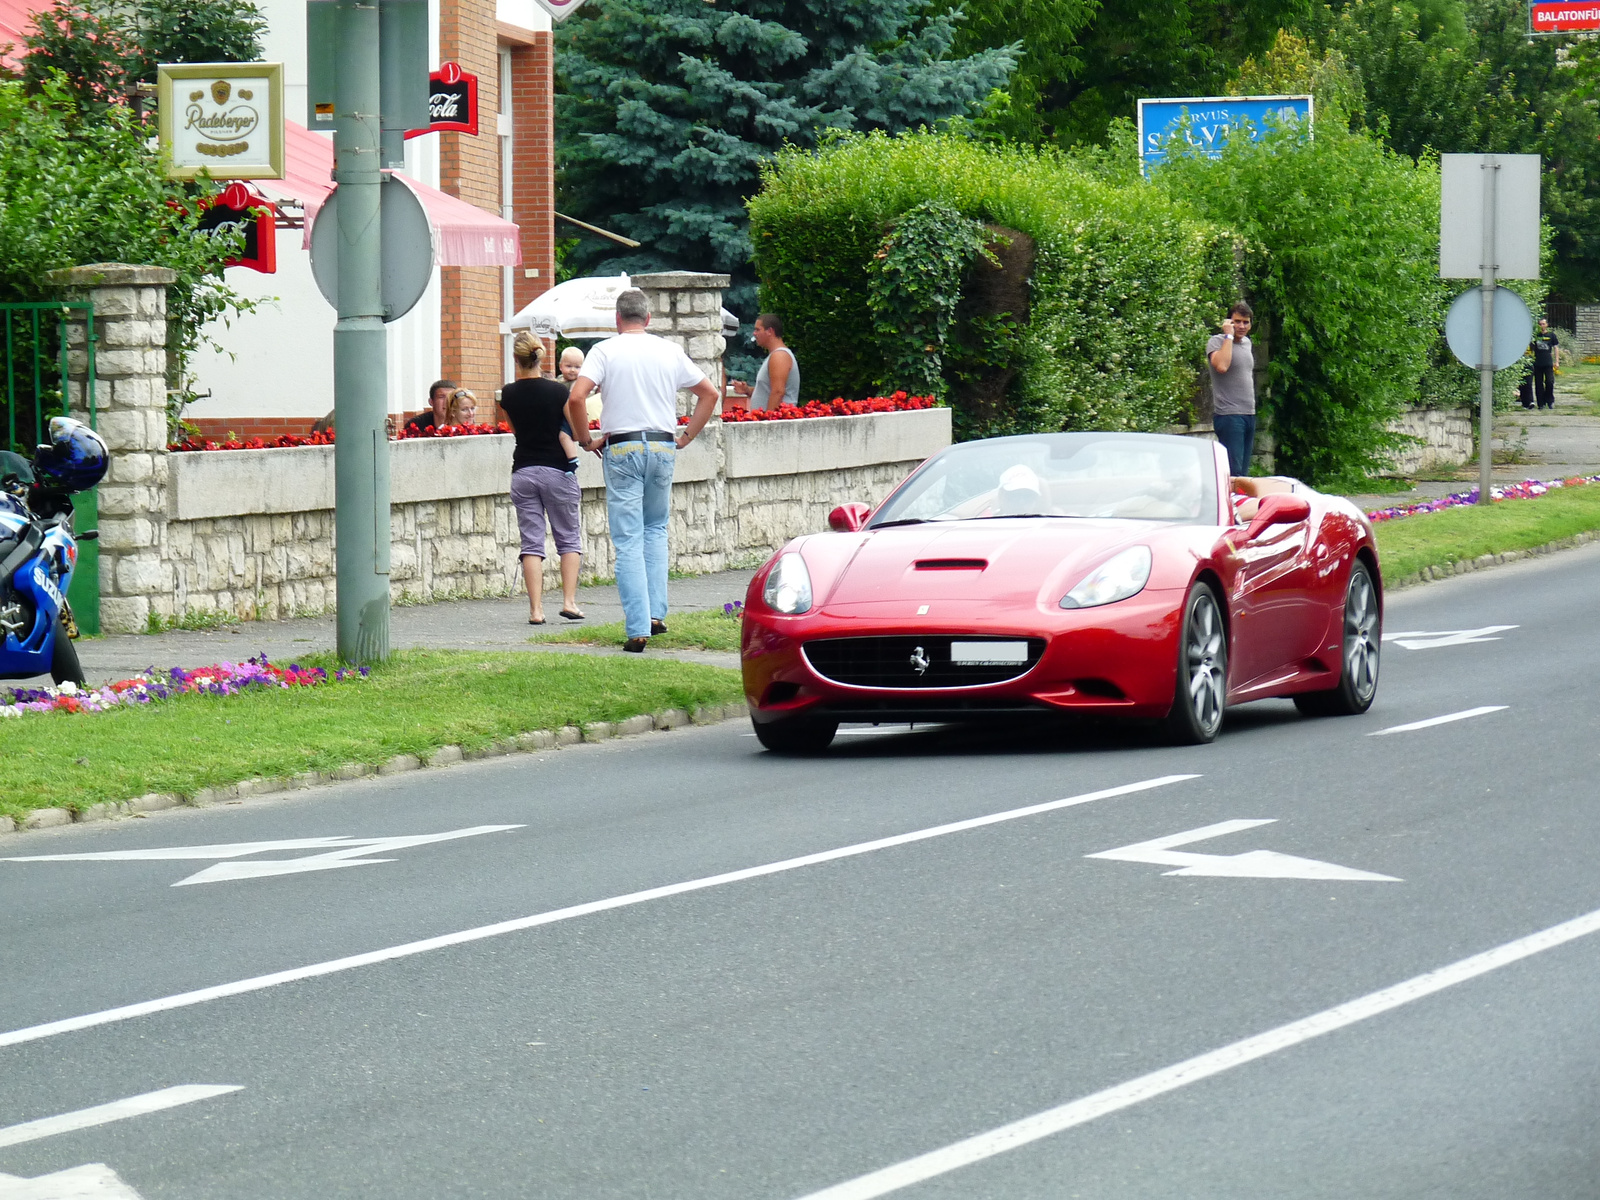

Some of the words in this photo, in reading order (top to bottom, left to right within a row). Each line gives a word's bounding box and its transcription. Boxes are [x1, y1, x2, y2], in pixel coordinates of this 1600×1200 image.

[1538, 8, 1600, 21] BALATONFÜ
[184, 103, 258, 140] Radeberger
[1172, 109, 1229, 126] SRVUS
